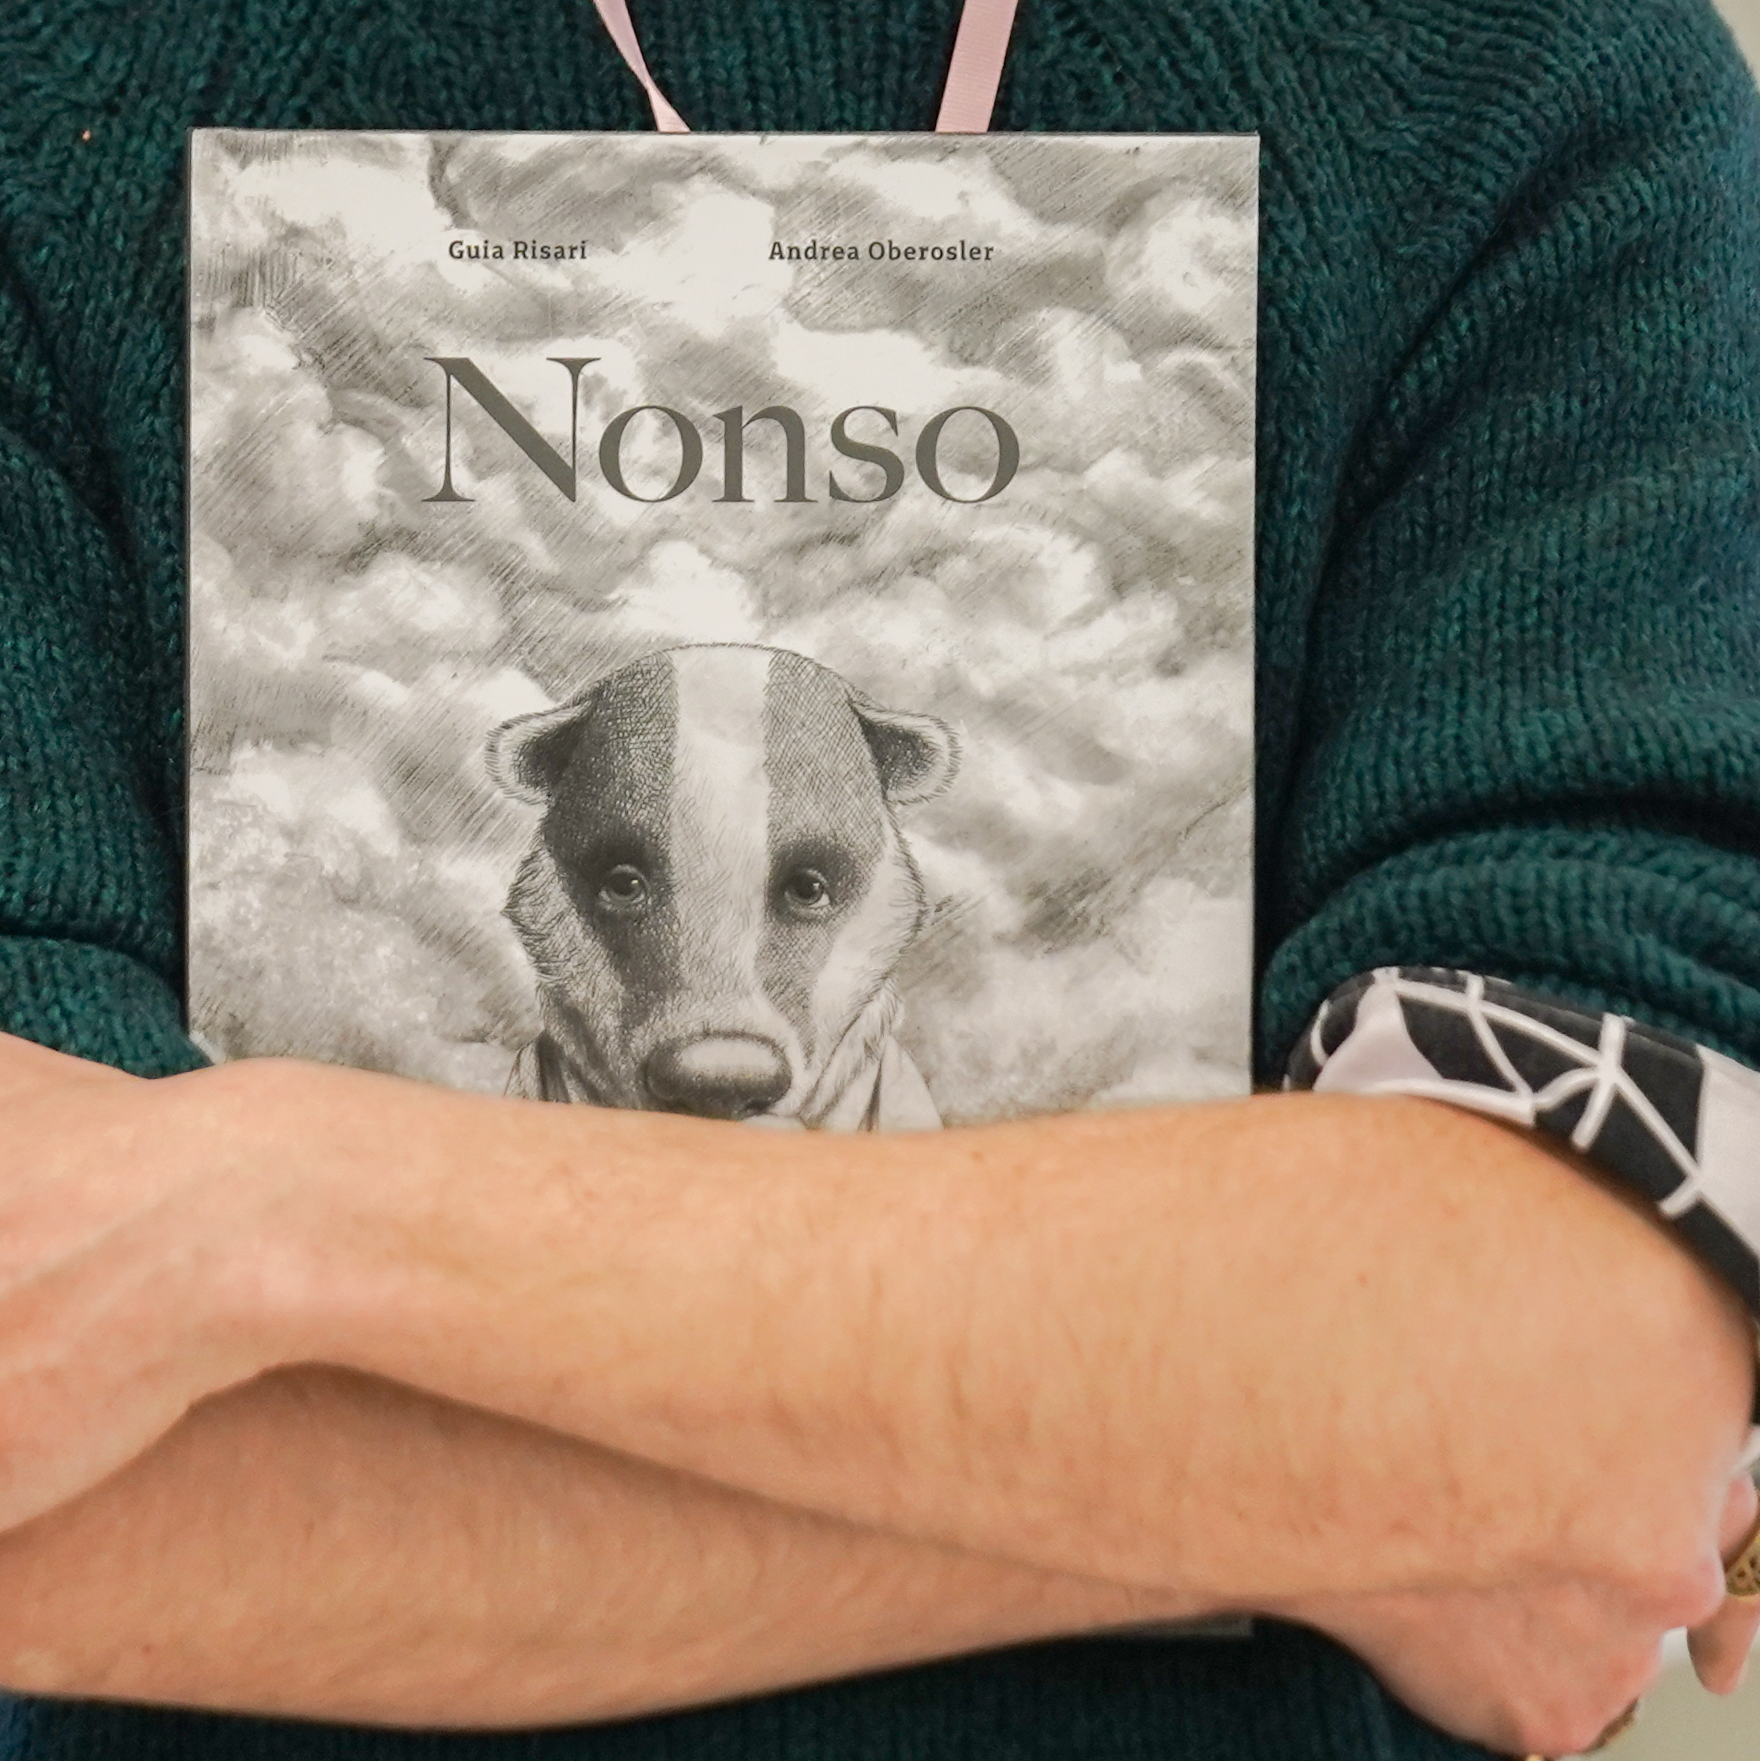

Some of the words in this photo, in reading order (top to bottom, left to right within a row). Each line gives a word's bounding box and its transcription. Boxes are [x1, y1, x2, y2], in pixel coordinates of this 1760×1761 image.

[448, 239, 505, 260] Guia
[513, 239, 587, 260] Risari
[769, 239, 861, 261] Andrea
[868, 240, 996, 261] Oberosler
[421, 356, 1021, 504] Nonso
